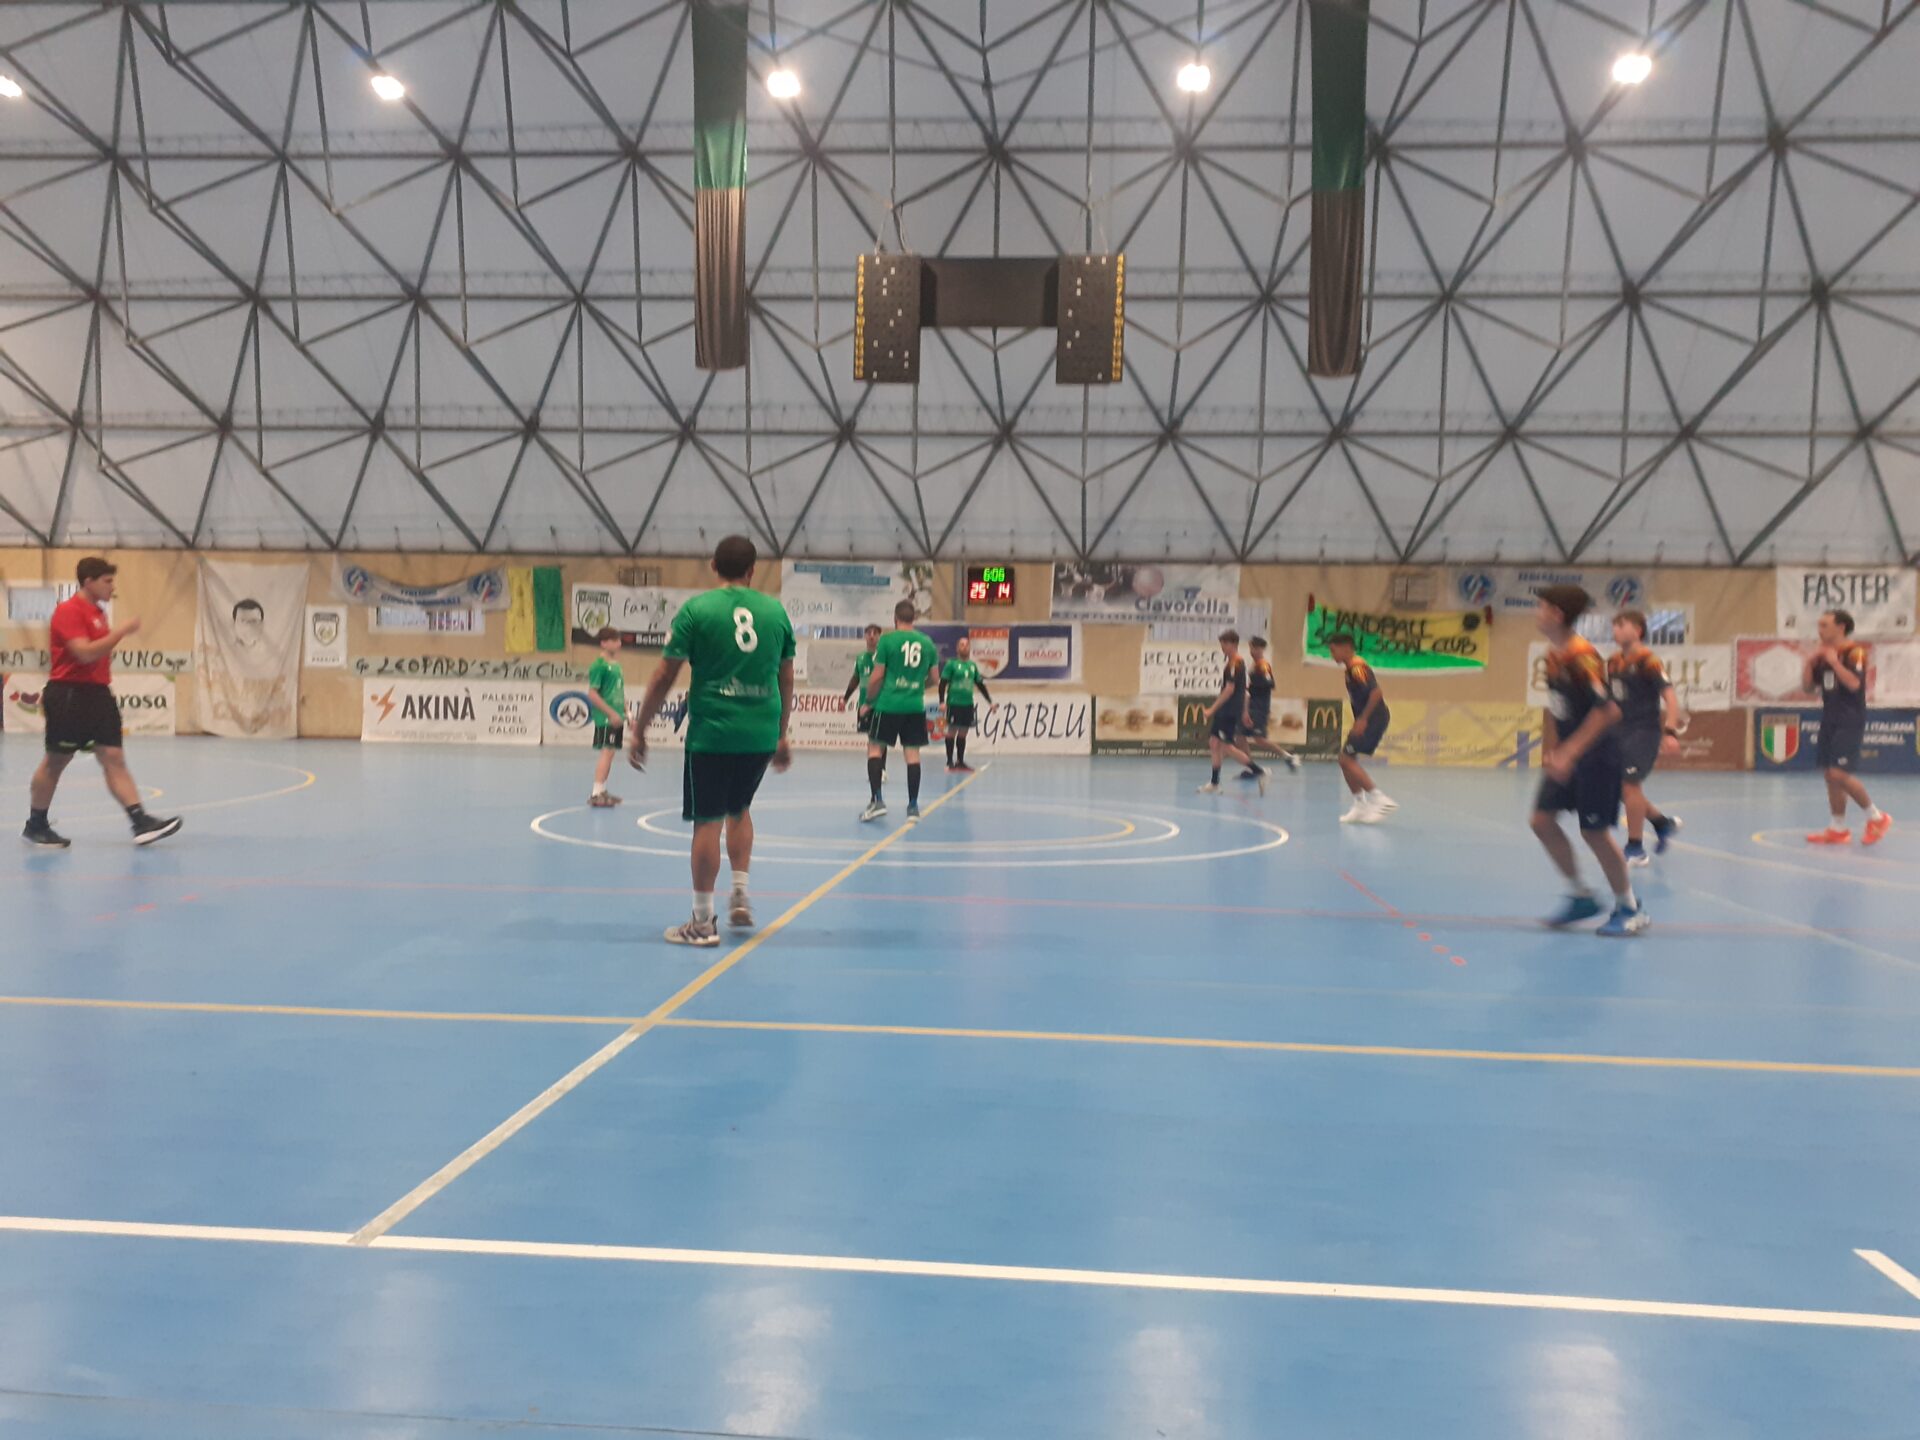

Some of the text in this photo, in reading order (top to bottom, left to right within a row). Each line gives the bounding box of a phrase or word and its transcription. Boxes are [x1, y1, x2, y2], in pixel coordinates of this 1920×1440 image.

[998, 583, 1010, 598] 14
[1803, 574, 1890, 605] FASTER
[733, 607, 758, 653] 8
[901, 640, 921, 668] 16
[401, 687, 476, 720] AKINÀ
[481, 693, 535, 702] PALESTRA
[488, 726, 528, 735] CALCIO
